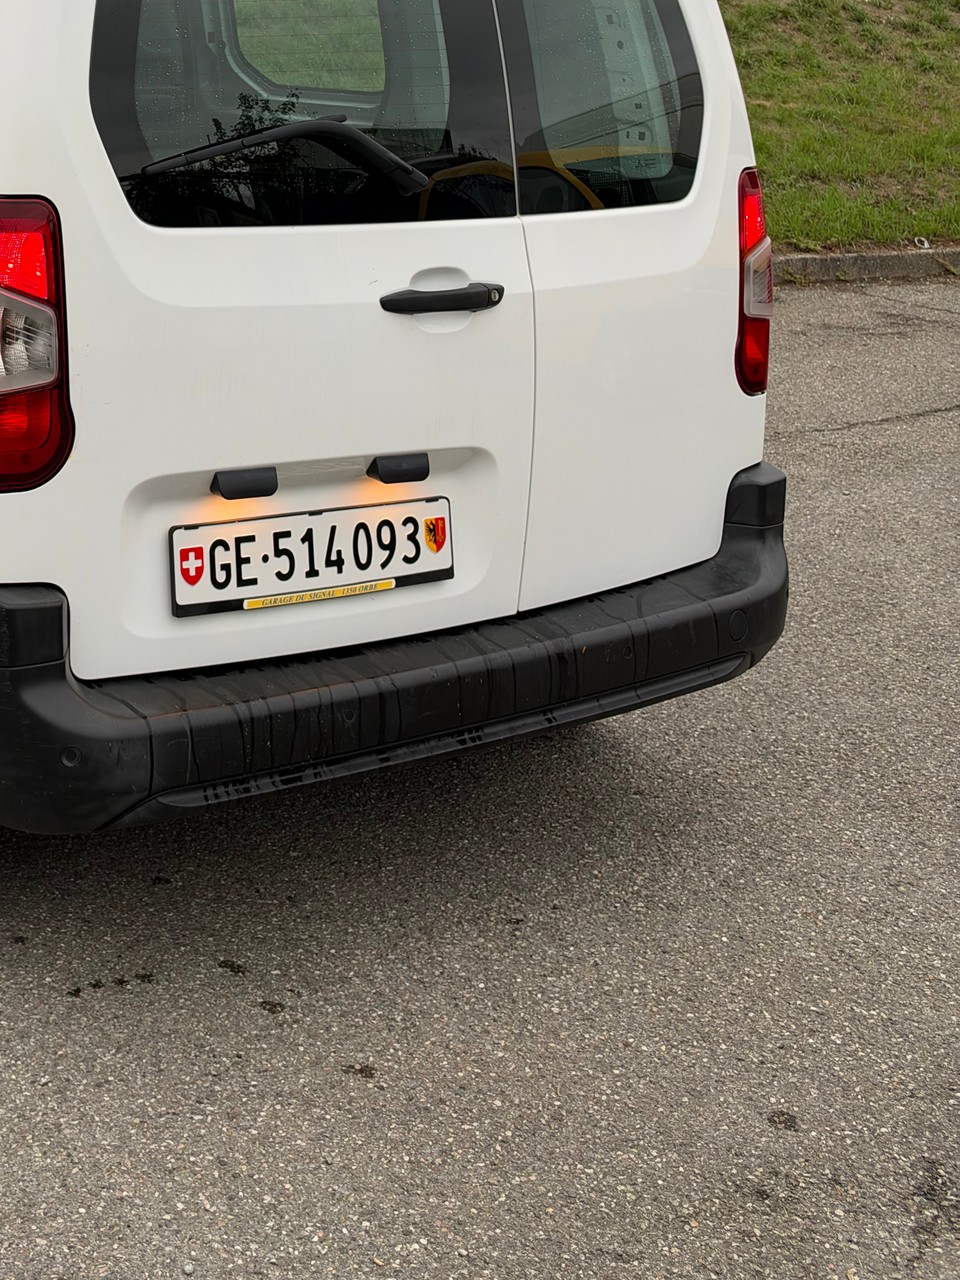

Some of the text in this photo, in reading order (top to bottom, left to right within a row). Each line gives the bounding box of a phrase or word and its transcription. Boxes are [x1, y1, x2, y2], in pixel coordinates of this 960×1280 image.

[261, 596, 293, 606] GARAGE
[295, 594, 308, 602] DU
[308, 590, 336, 600] SIGNAL
[358, 583, 379, 593] ORBE
